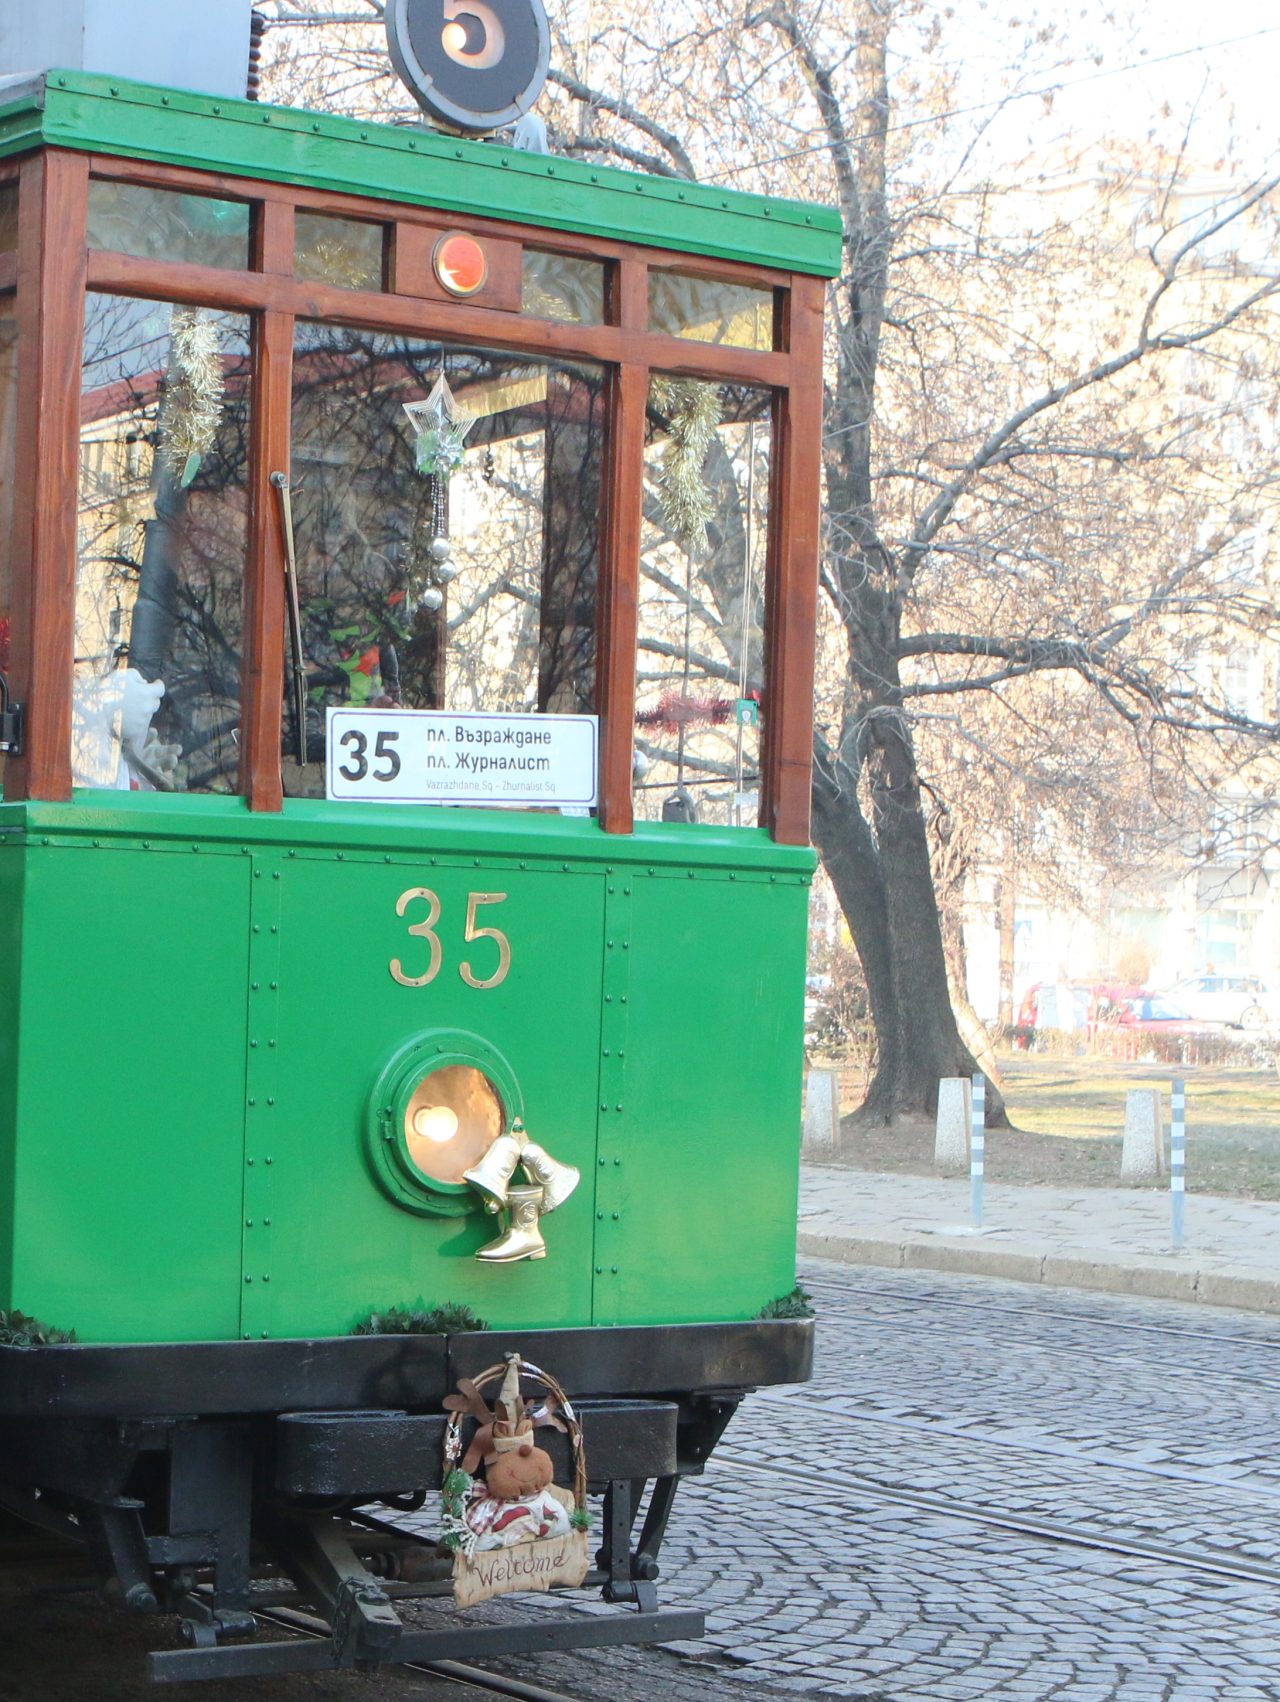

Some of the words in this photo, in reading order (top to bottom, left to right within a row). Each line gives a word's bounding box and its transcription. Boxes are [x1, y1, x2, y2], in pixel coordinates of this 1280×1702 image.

[441, 0, 506, 70] 5
[427, 728, 451, 742] пл.
[455, 725, 552, 748] Възраждане
[338, 729, 402, 783] 35
[426, 754, 451, 769] пл.
[455, 752, 550, 773] Журналист
[426, 780, 480, 791] Vazrazhdane
[502, 780, 543, 792] Zhurnalist
[389, 886, 512, 990] 35
[472, 1553, 570, 1588] Welcome
